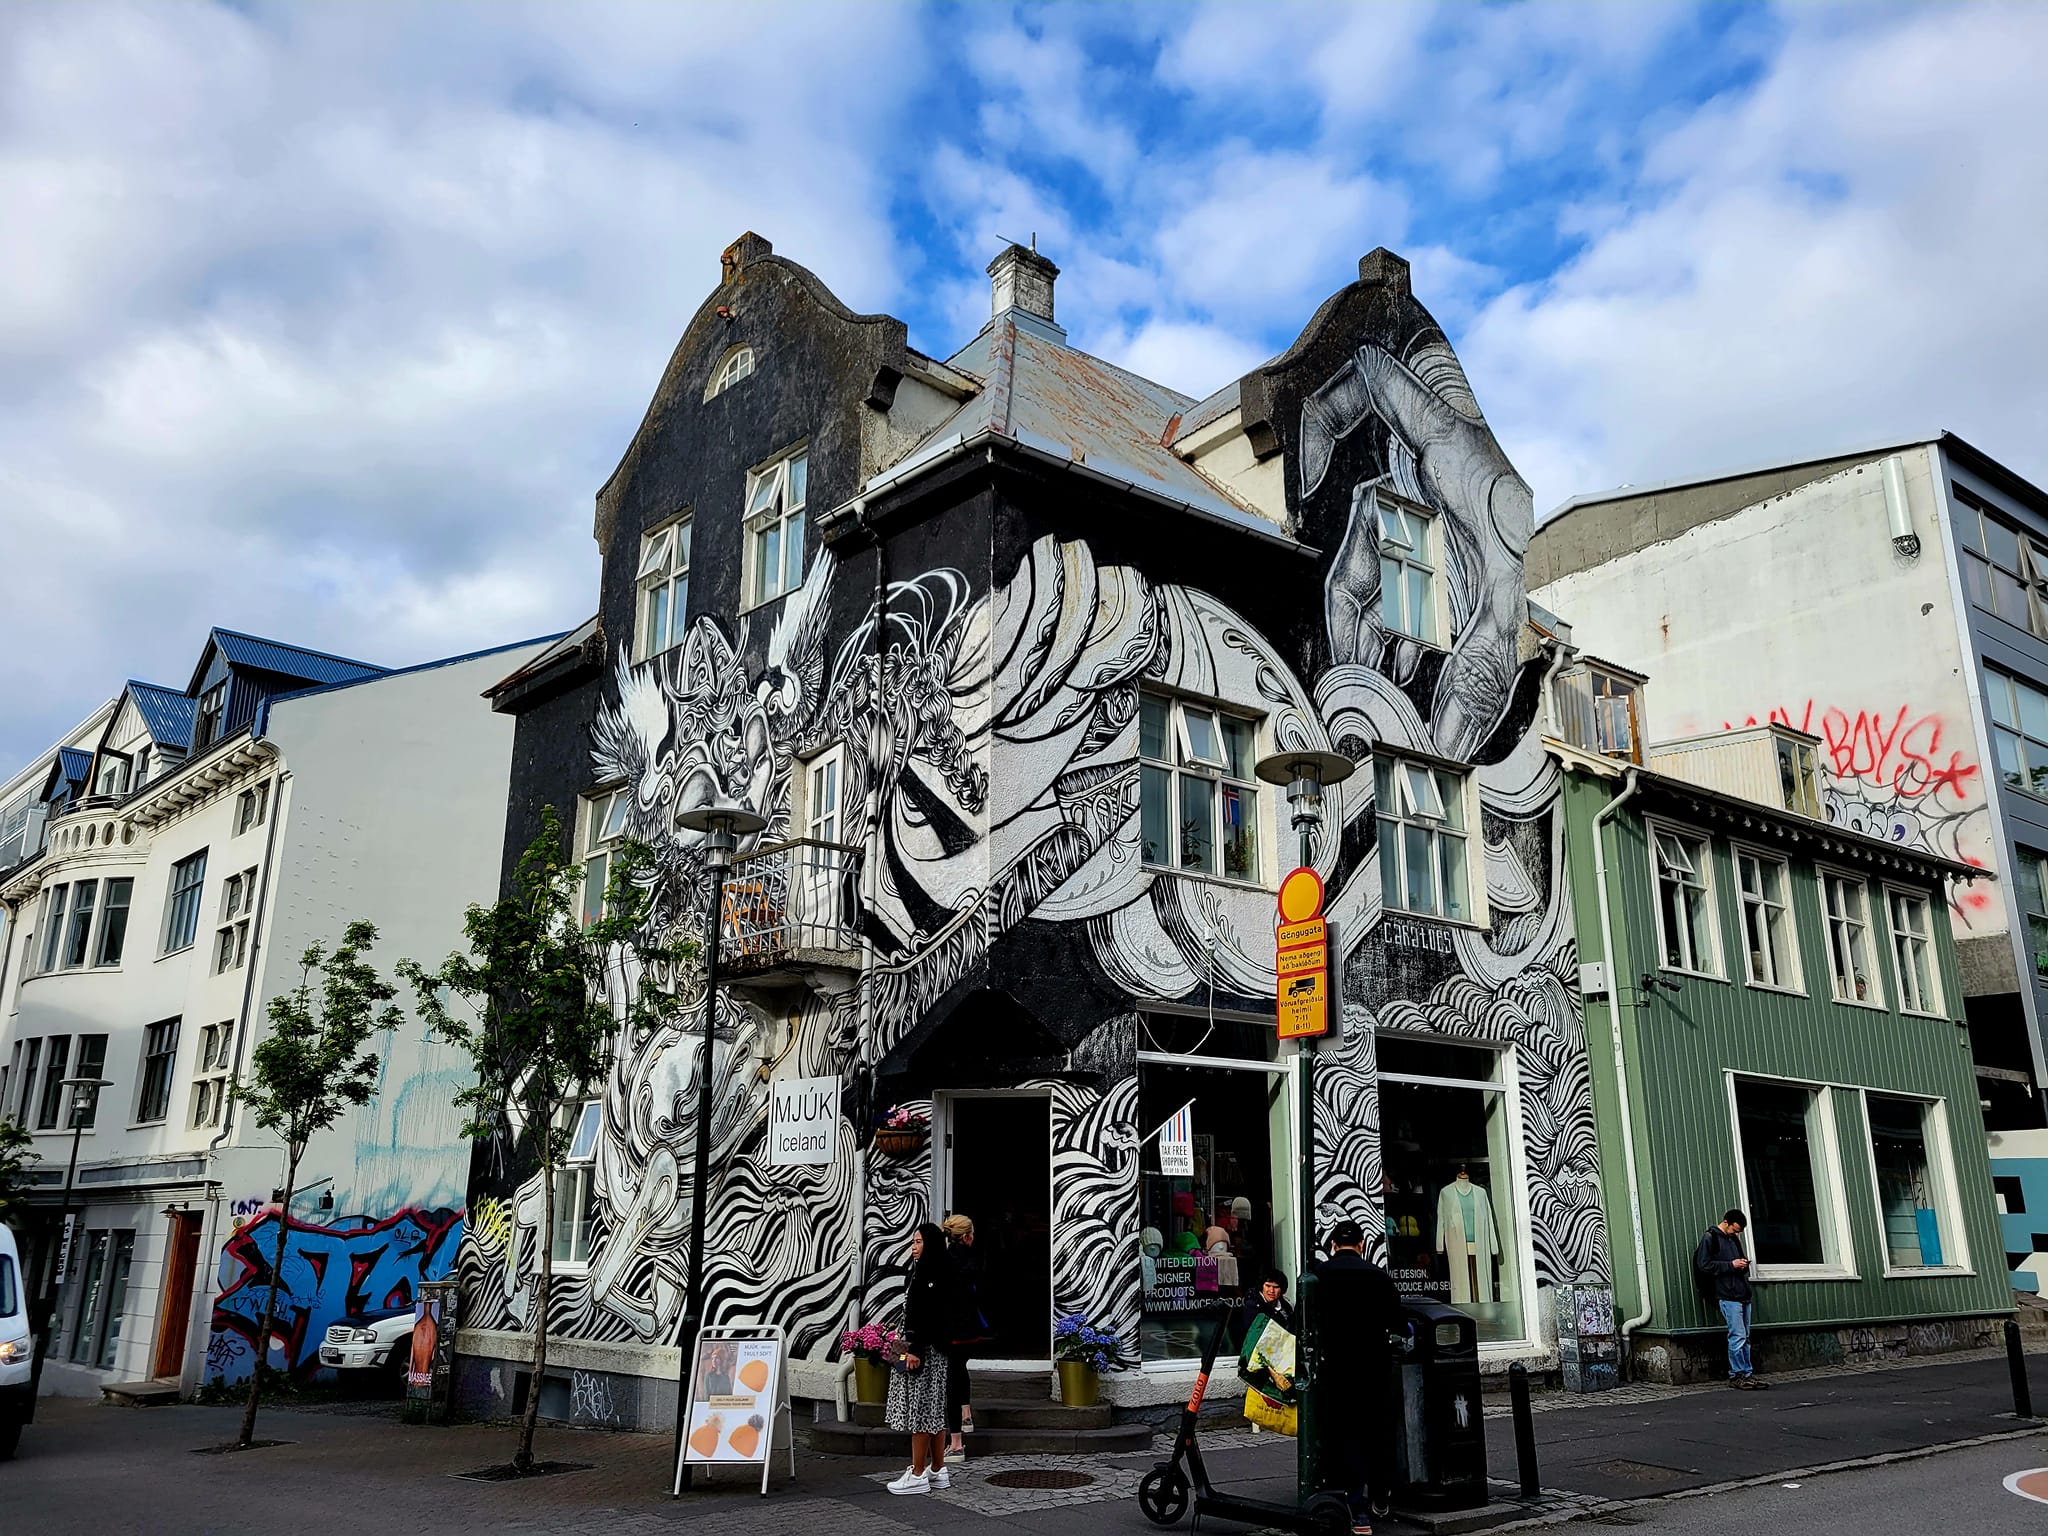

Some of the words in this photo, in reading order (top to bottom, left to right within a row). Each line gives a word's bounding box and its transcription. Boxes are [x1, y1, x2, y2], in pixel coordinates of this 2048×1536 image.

[1280, 926, 1322, 940] Göngugata
[1280, 954, 1297, 962] Nema
[775, 1086, 834, 1123] MJÚK
[779, 1130, 827, 1152] Iceland
[1161, 1145, 1171, 1156] TAX
[1172, 1145, 1188, 1156] FREE
[1162, 1157, 1189, 1167] SHOPPING
[1182, 1257, 1217, 1267] EDITION
[1400, 1269, 1429, 1279] DESIGN,
[1424, 1281, 1438, 1290] AND
[1145, 1287, 1195, 1298] PRODUCTS
